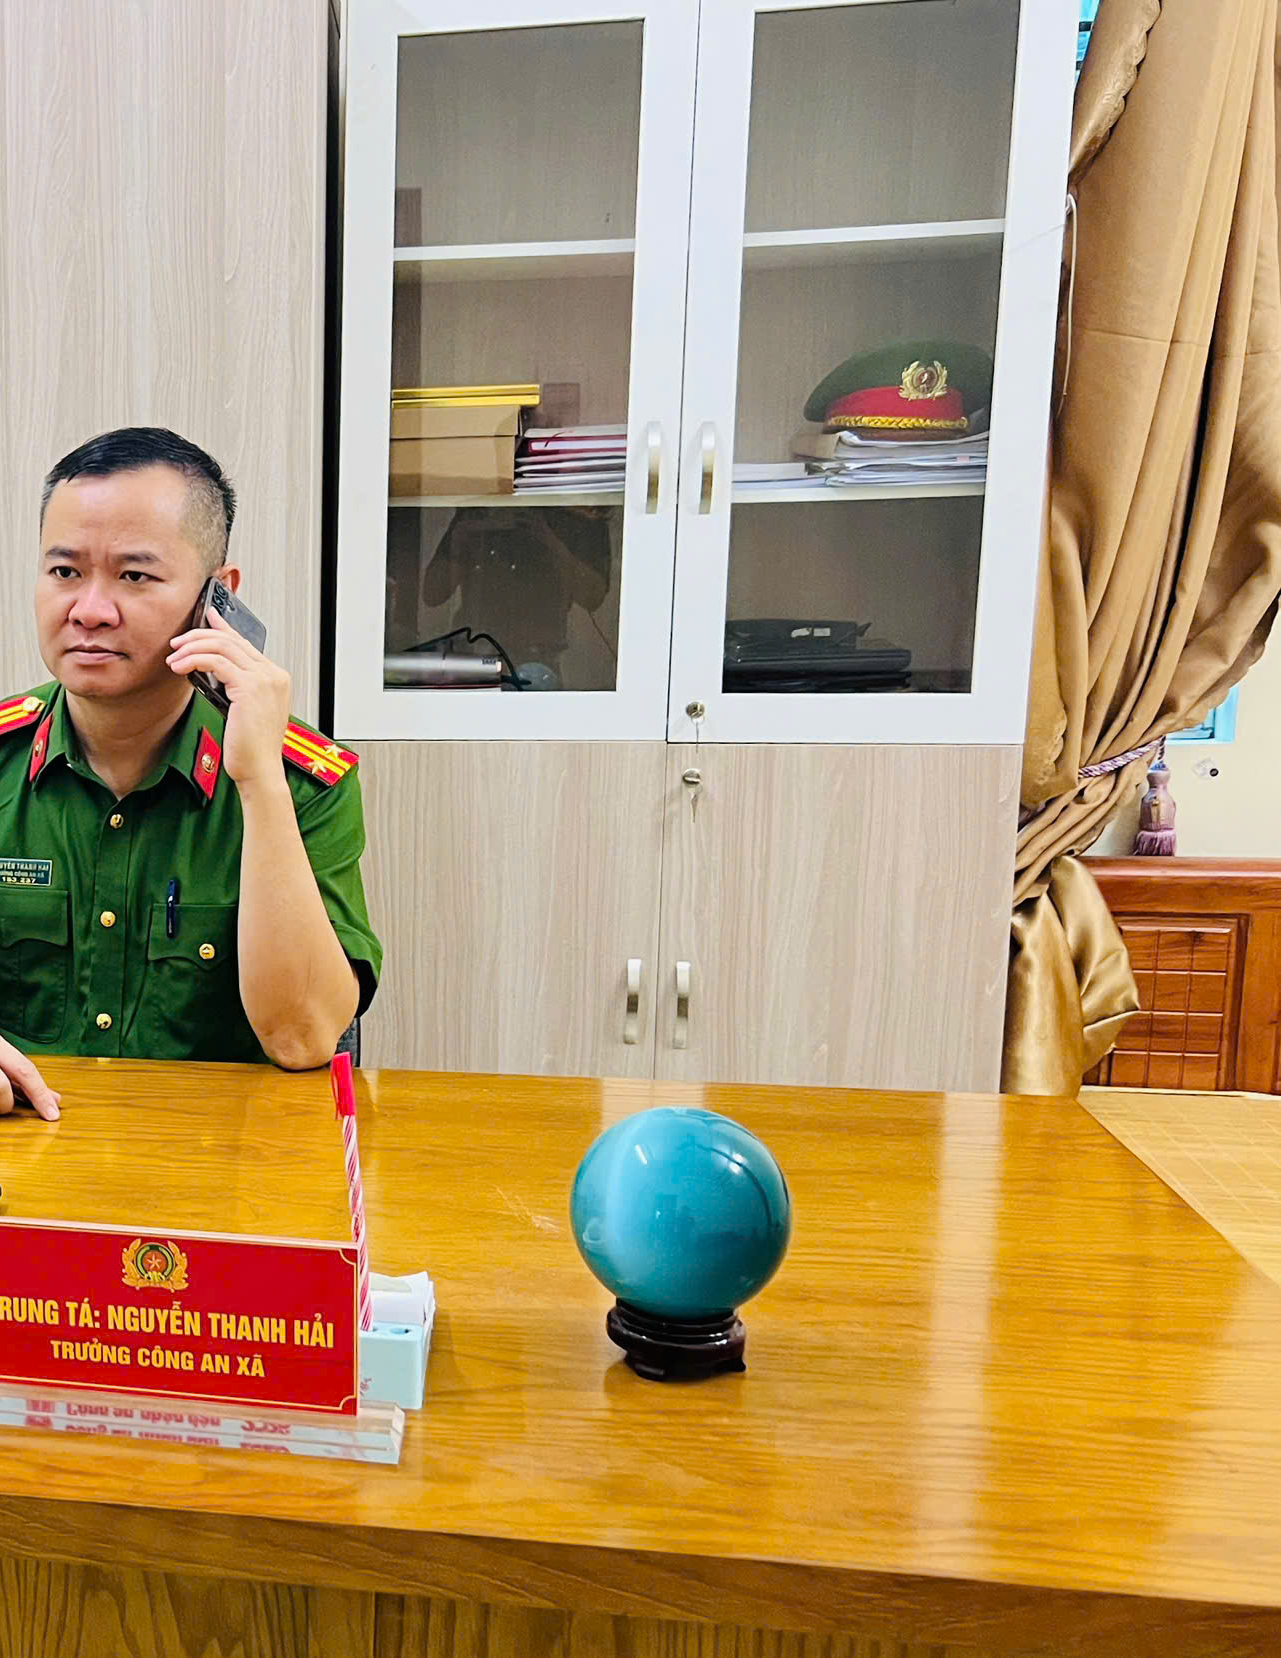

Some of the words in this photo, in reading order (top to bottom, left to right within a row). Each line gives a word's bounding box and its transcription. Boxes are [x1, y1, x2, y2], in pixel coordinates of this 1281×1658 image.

[65, 1297, 100, 1329] TÁ:
[107, 1301, 201, 1337] NGUYỄN
[207, 1312, 286, 1344] THANH
[293, 1312, 334, 1348] HẢI
[50, 1338, 131, 1365] TRƯỞNG
[137, 1345, 194, 1371] CÔNG
[200, 1353, 230, 1374] AN
[236, 1353, 265, 1378] XÃ
